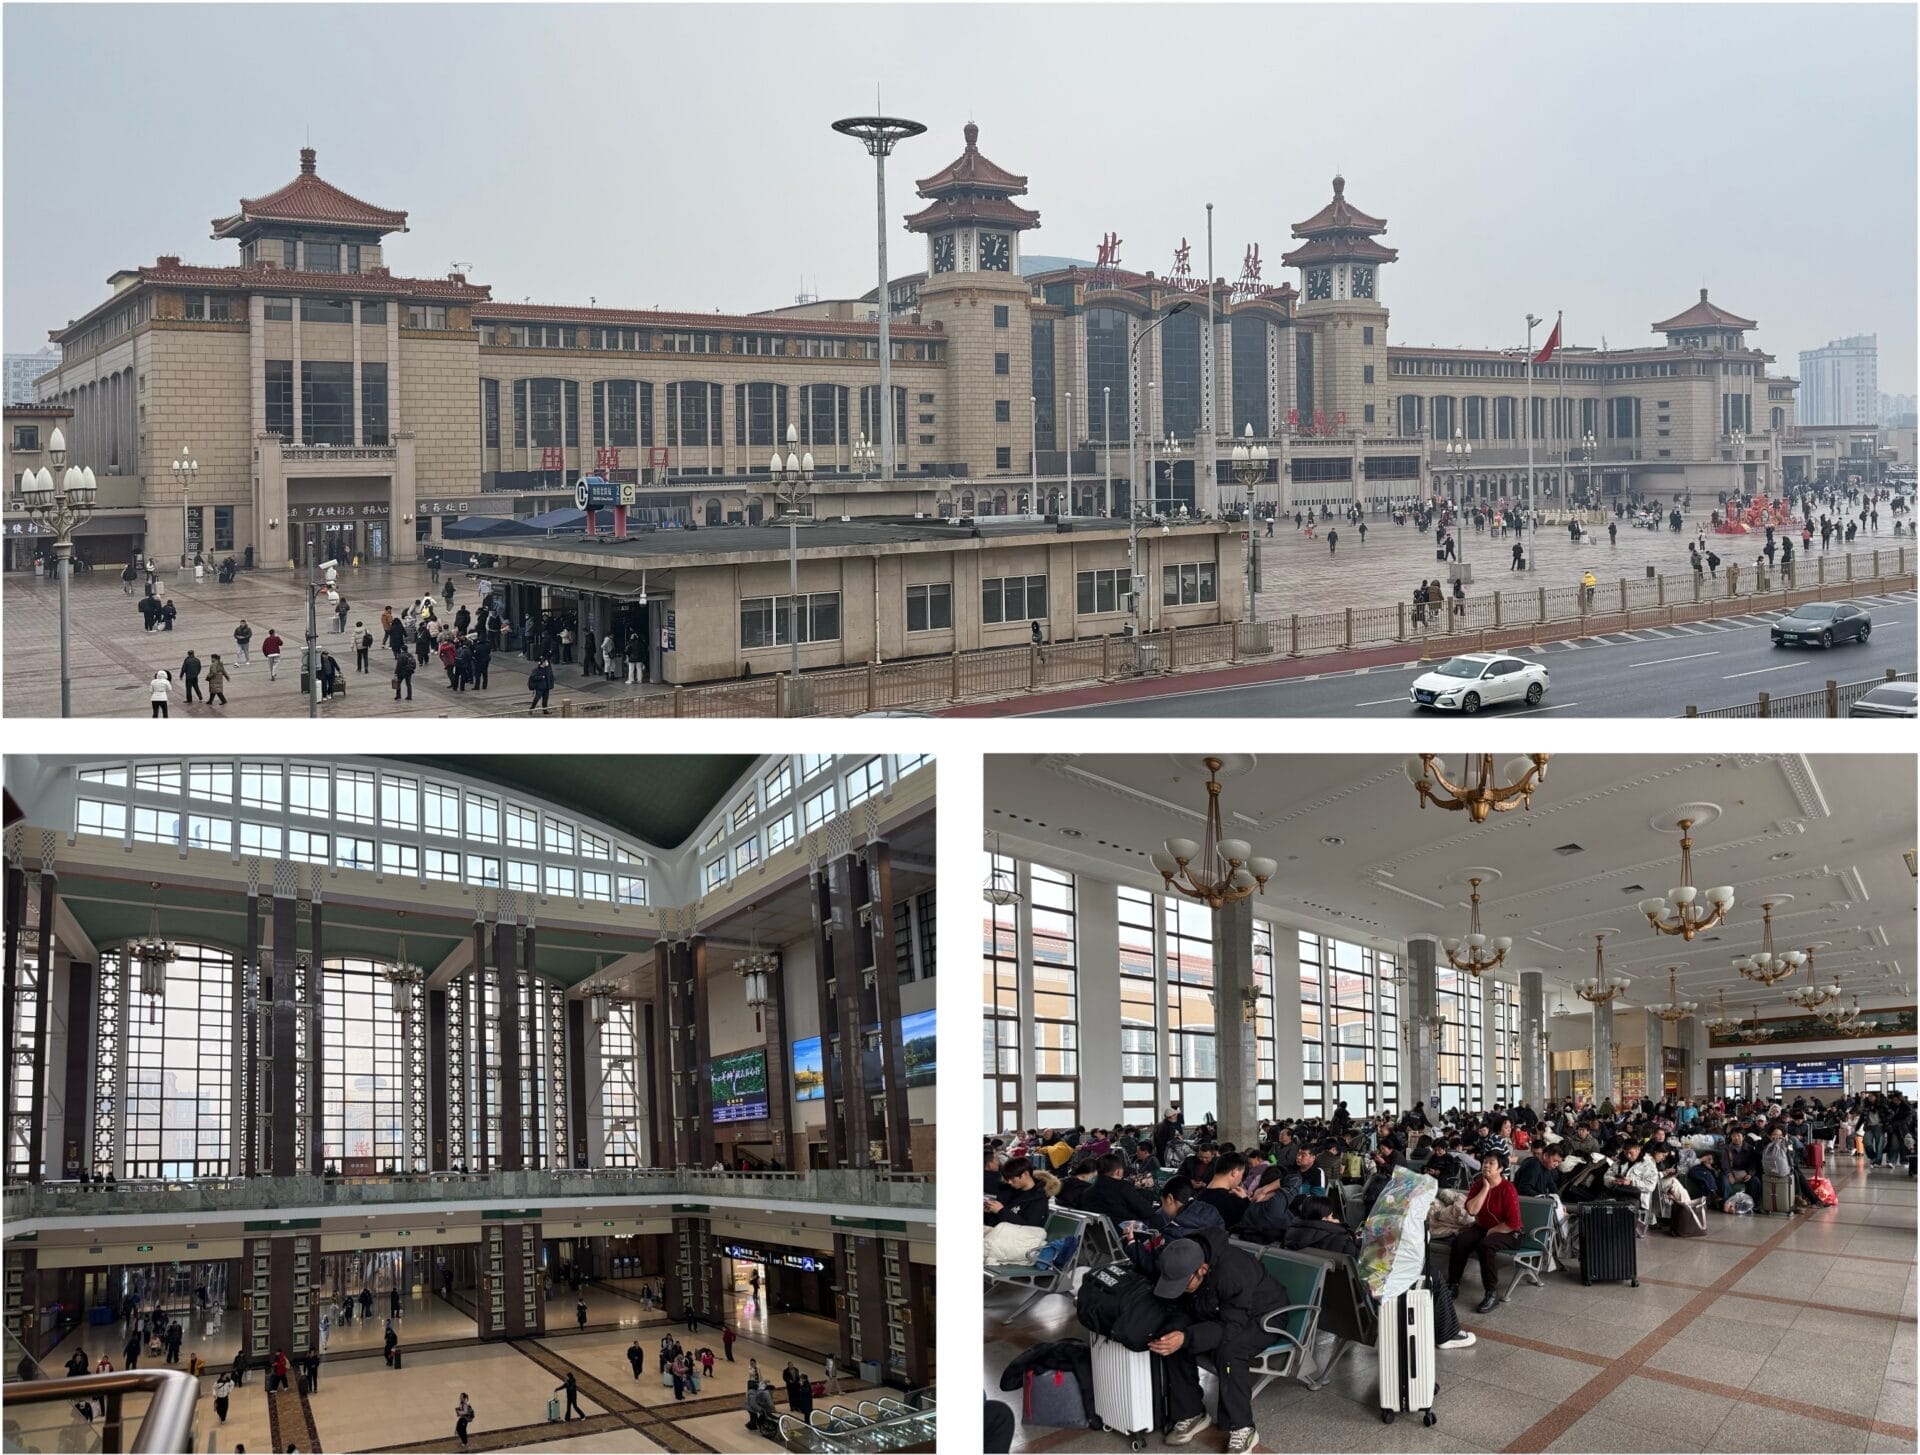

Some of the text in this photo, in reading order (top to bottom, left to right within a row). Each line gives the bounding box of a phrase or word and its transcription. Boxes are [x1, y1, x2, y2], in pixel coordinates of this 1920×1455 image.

[1161, 275, 1209, 291] RAILWAY
[1231, 281, 1274, 295] STATION
[542, 445, 669, 471] 出站口
[623, 485, 633, 497] C
